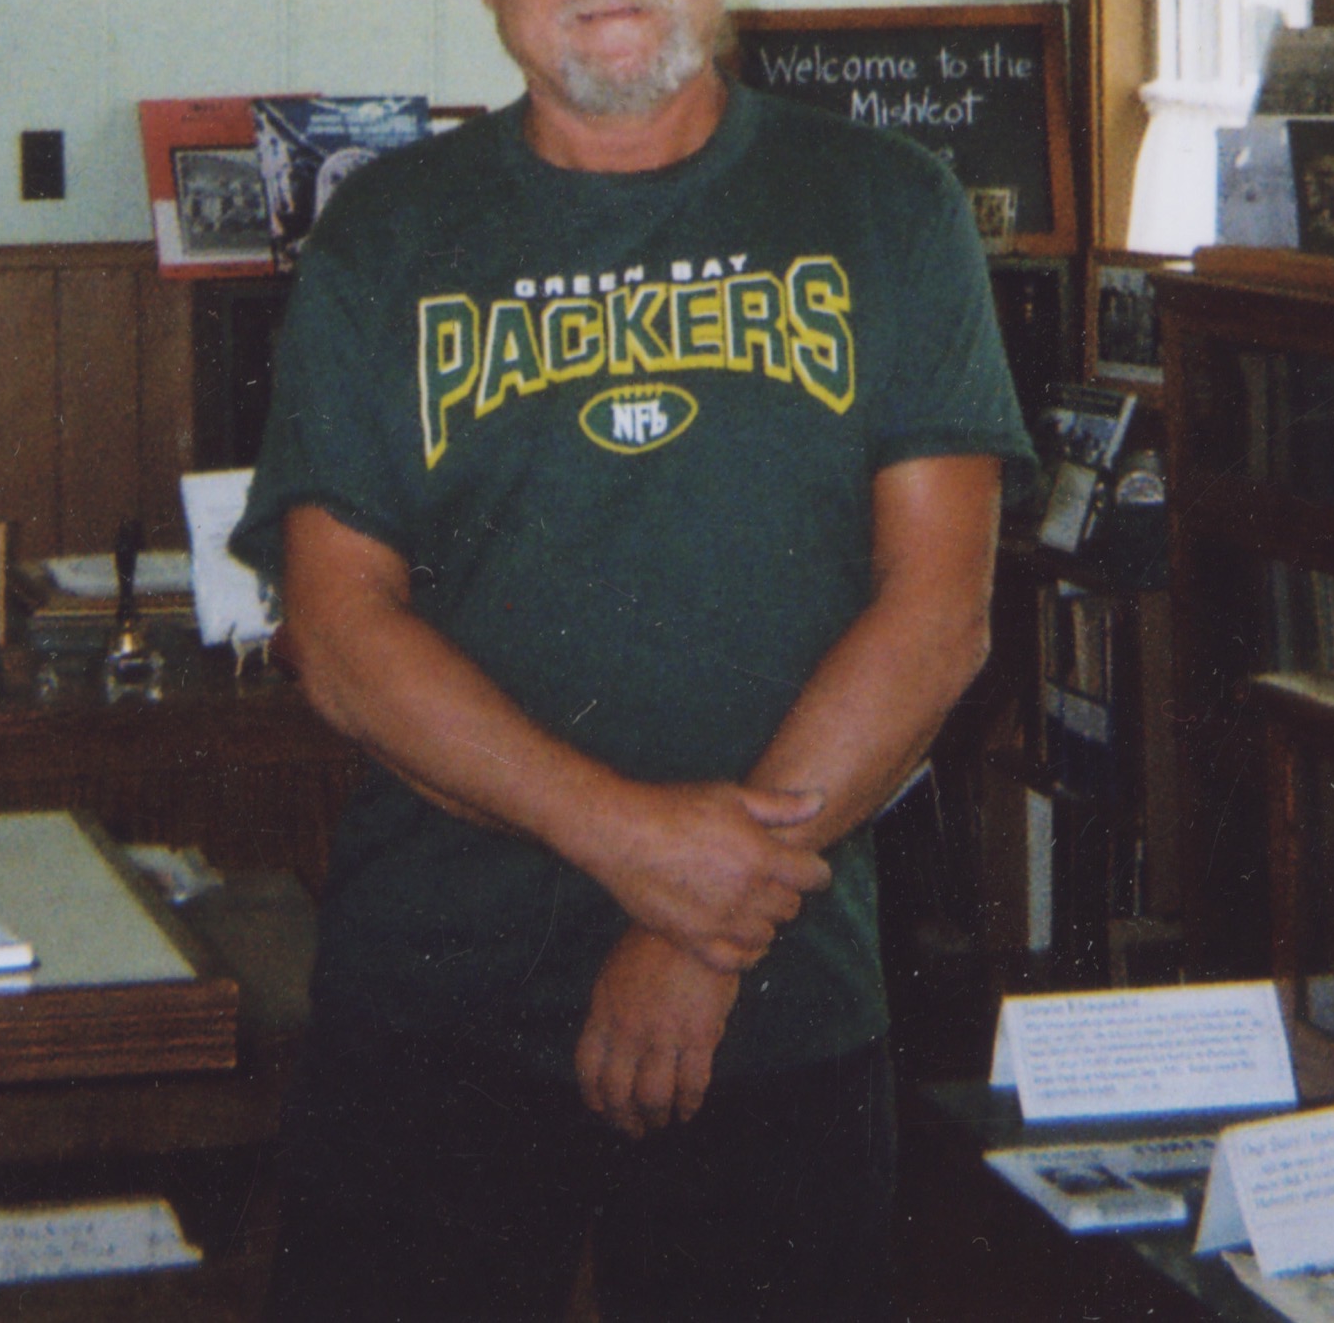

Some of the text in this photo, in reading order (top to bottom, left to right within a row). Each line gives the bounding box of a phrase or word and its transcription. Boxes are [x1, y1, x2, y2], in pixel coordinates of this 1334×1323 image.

[761, 42, 1032, 84] Welcome to the
[514, 253, 748, 299] GREEN BAY
[419, 254, 856, 471] PACKERS
[611, 398, 668, 445] NFL
